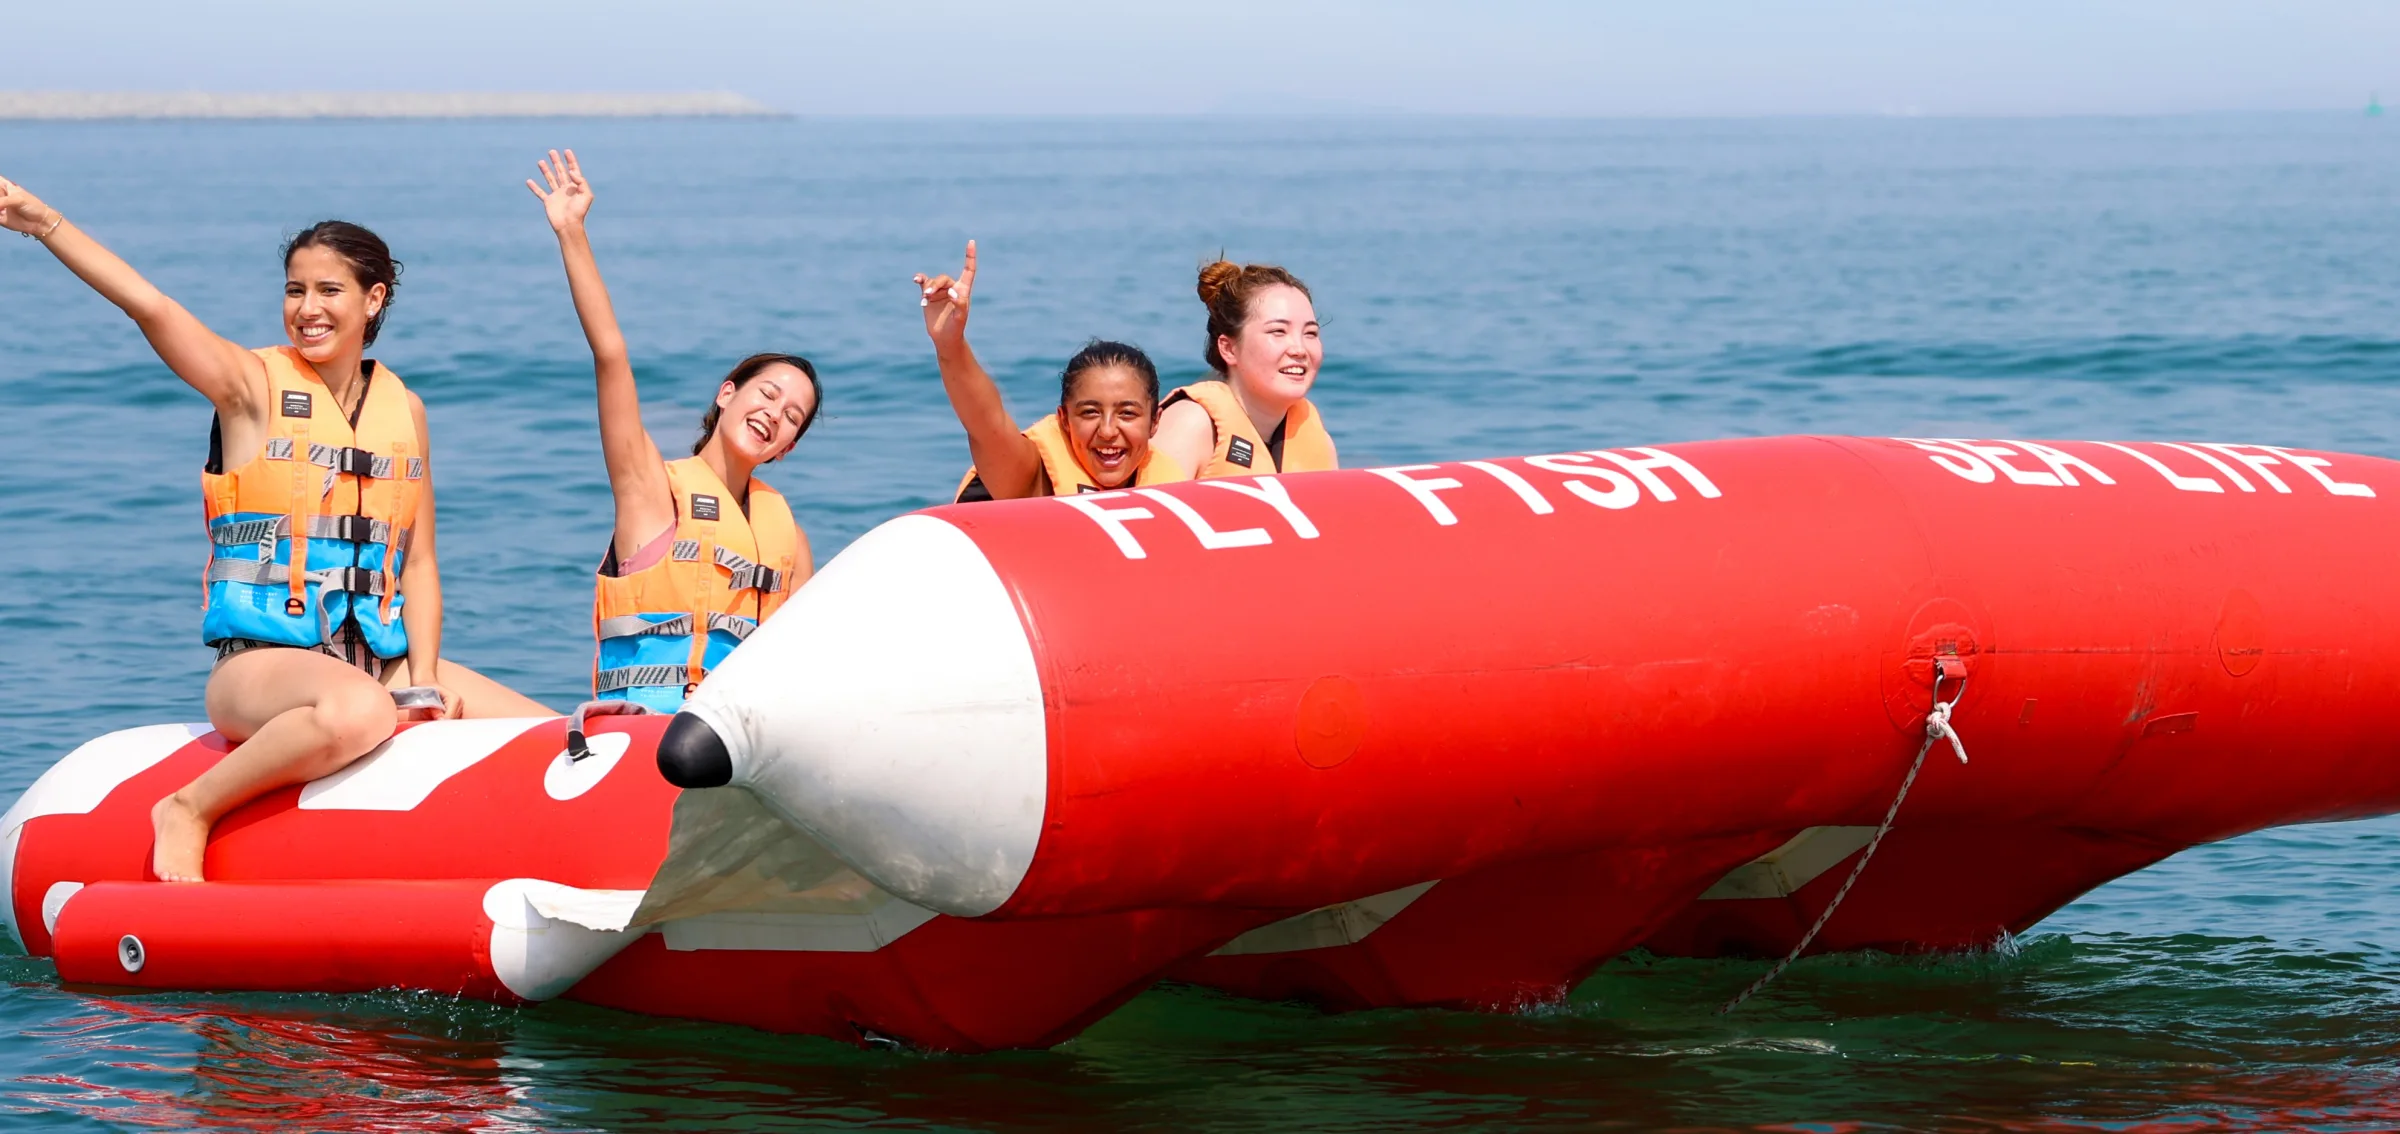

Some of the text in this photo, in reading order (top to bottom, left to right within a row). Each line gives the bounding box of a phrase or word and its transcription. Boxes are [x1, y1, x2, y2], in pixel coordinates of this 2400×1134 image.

[1051, 446, 1723, 560] FLY FISH
[1887, 437, 2377, 498] SEA LIFE
